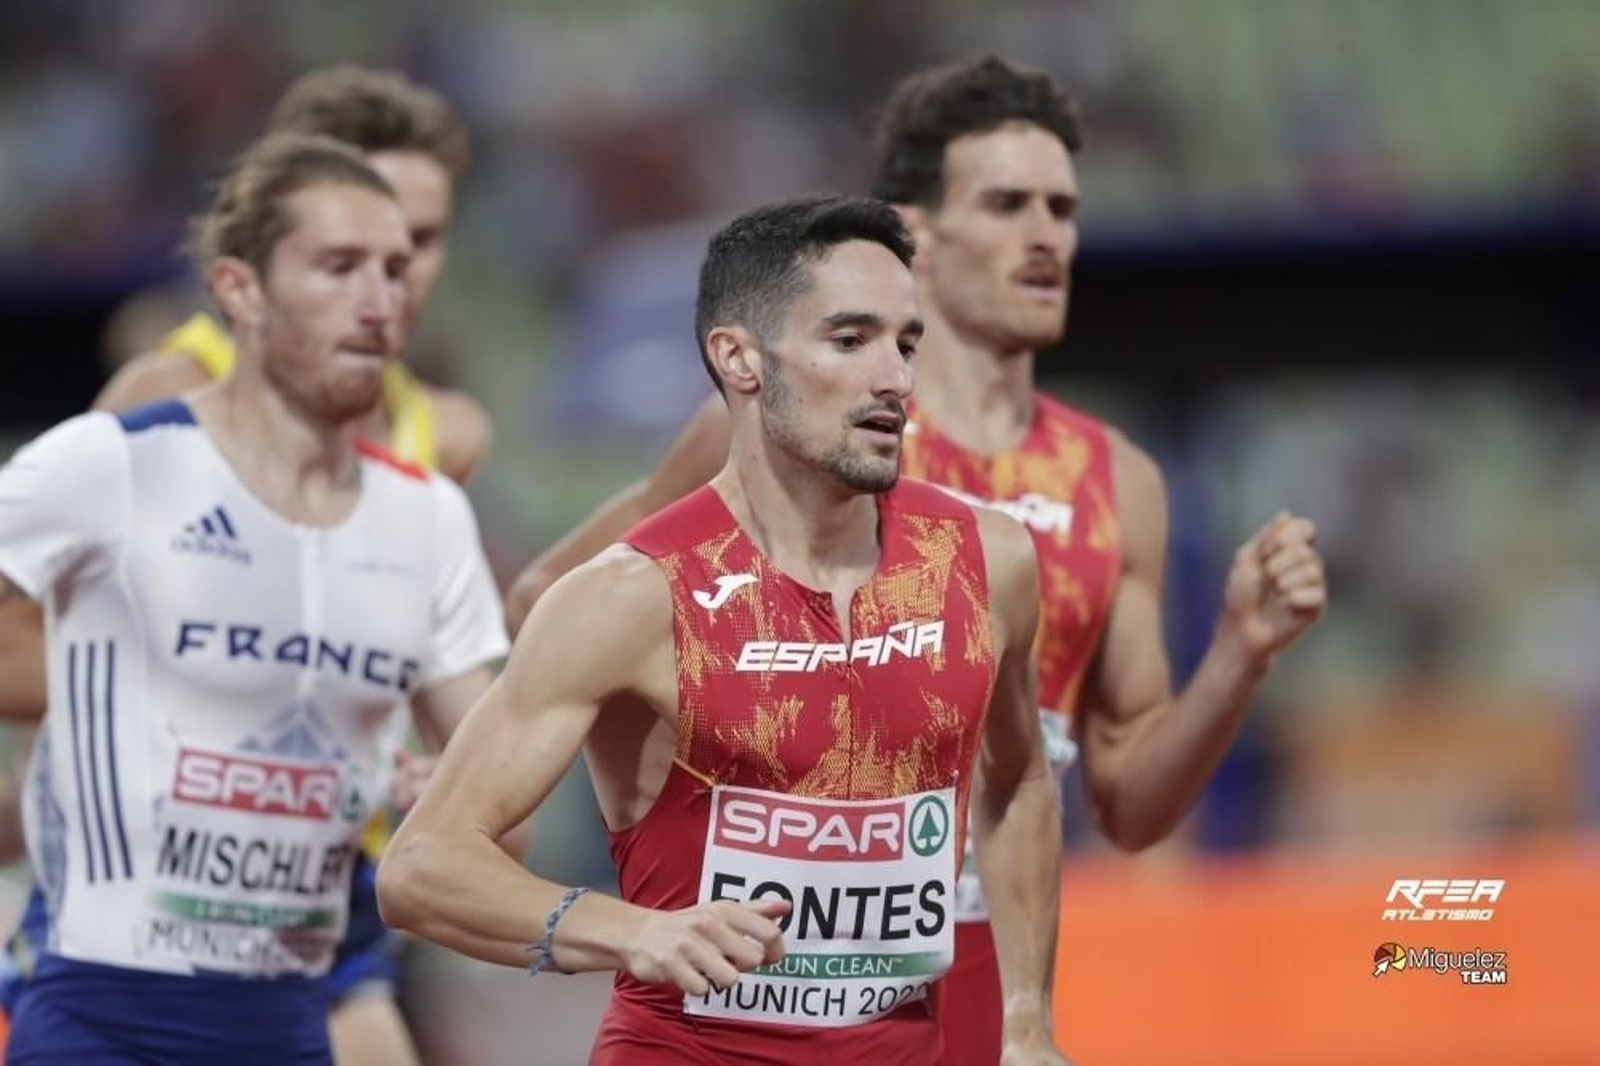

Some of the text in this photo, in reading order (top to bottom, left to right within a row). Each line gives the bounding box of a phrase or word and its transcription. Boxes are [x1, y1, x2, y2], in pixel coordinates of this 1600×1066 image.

[735, 620, 945, 672] ESPAÑA
[177, 754, 337, 815] SPAR
[720, 799, 900, 854] SPAR
[710, 872, 946, 941] FONTES
[703, 979, 846, 1017] MUNICH
